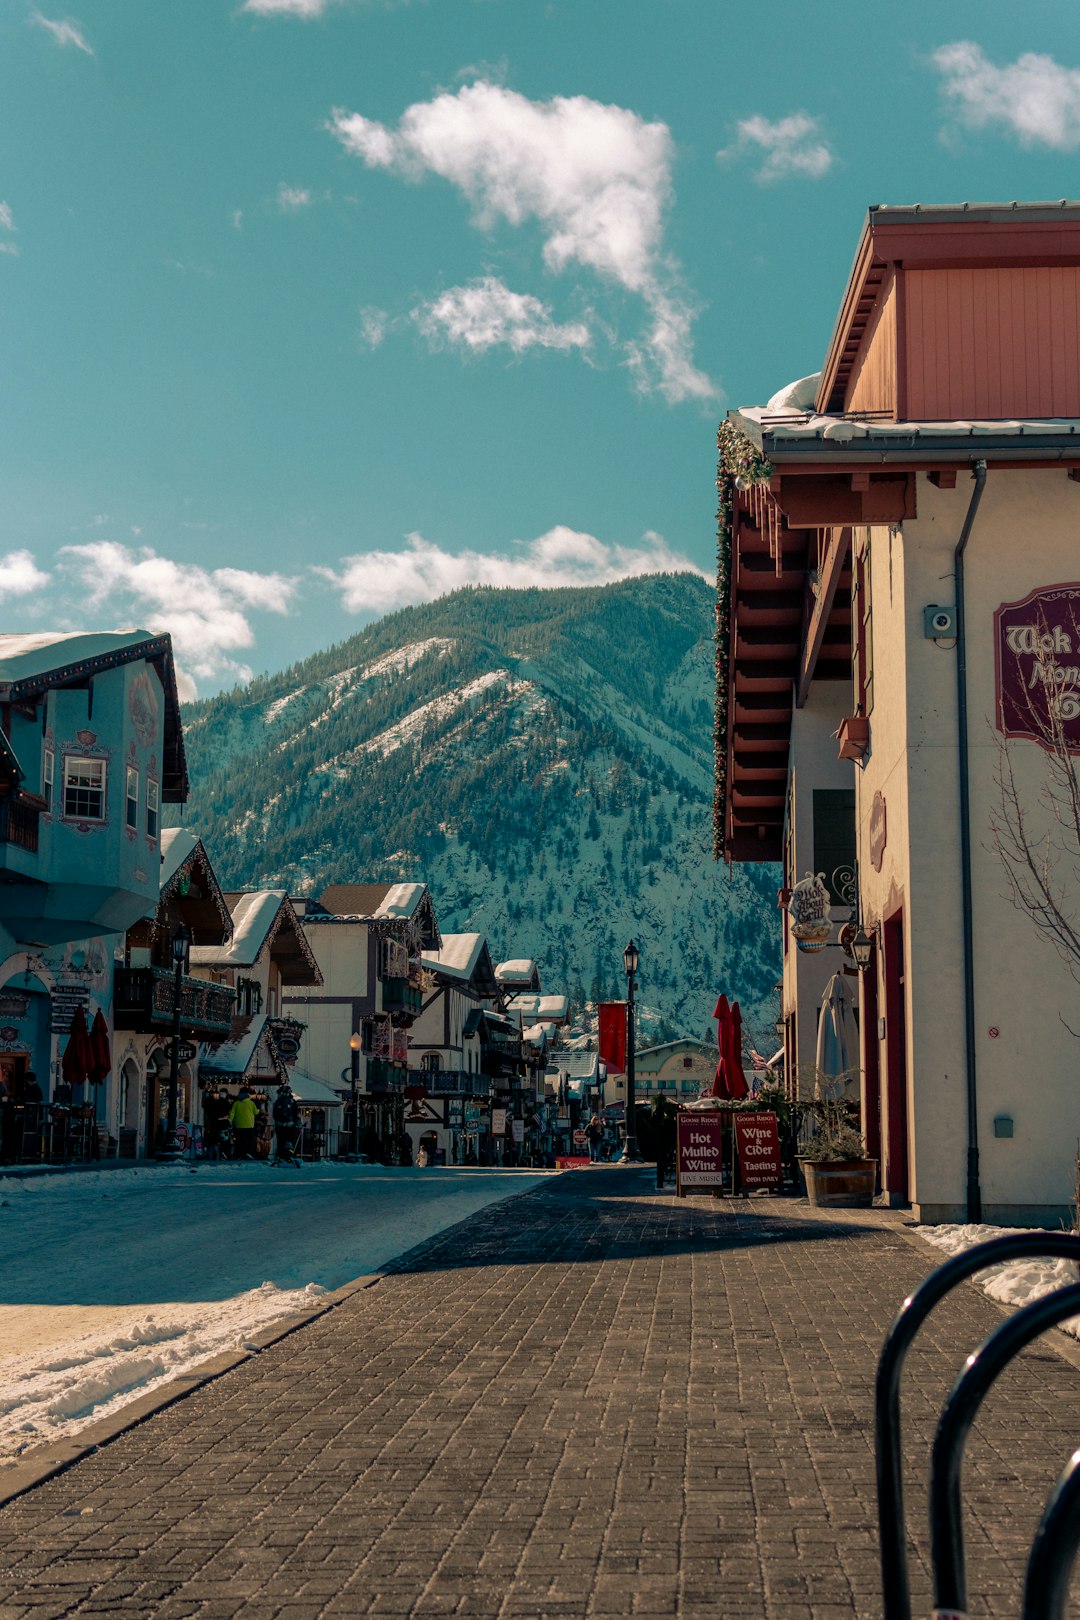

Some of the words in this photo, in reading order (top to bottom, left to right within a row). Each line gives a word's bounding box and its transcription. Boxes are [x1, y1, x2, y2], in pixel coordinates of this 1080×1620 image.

[1006, 625, 1072, 655] Wok
[798, 898, 825, 912] About
[797, 907, 824, 923] Grill
[690, 1132, 712, 1144] Hot
[742, 1128, 772, 1139] Wine
[682, 1146, 719, 1157] Mulled
[745, 1145, 773, 1156] Cider
[686, 1160, 717, 1171] Wine
[744, 1161, 777, 1172] Tasting
